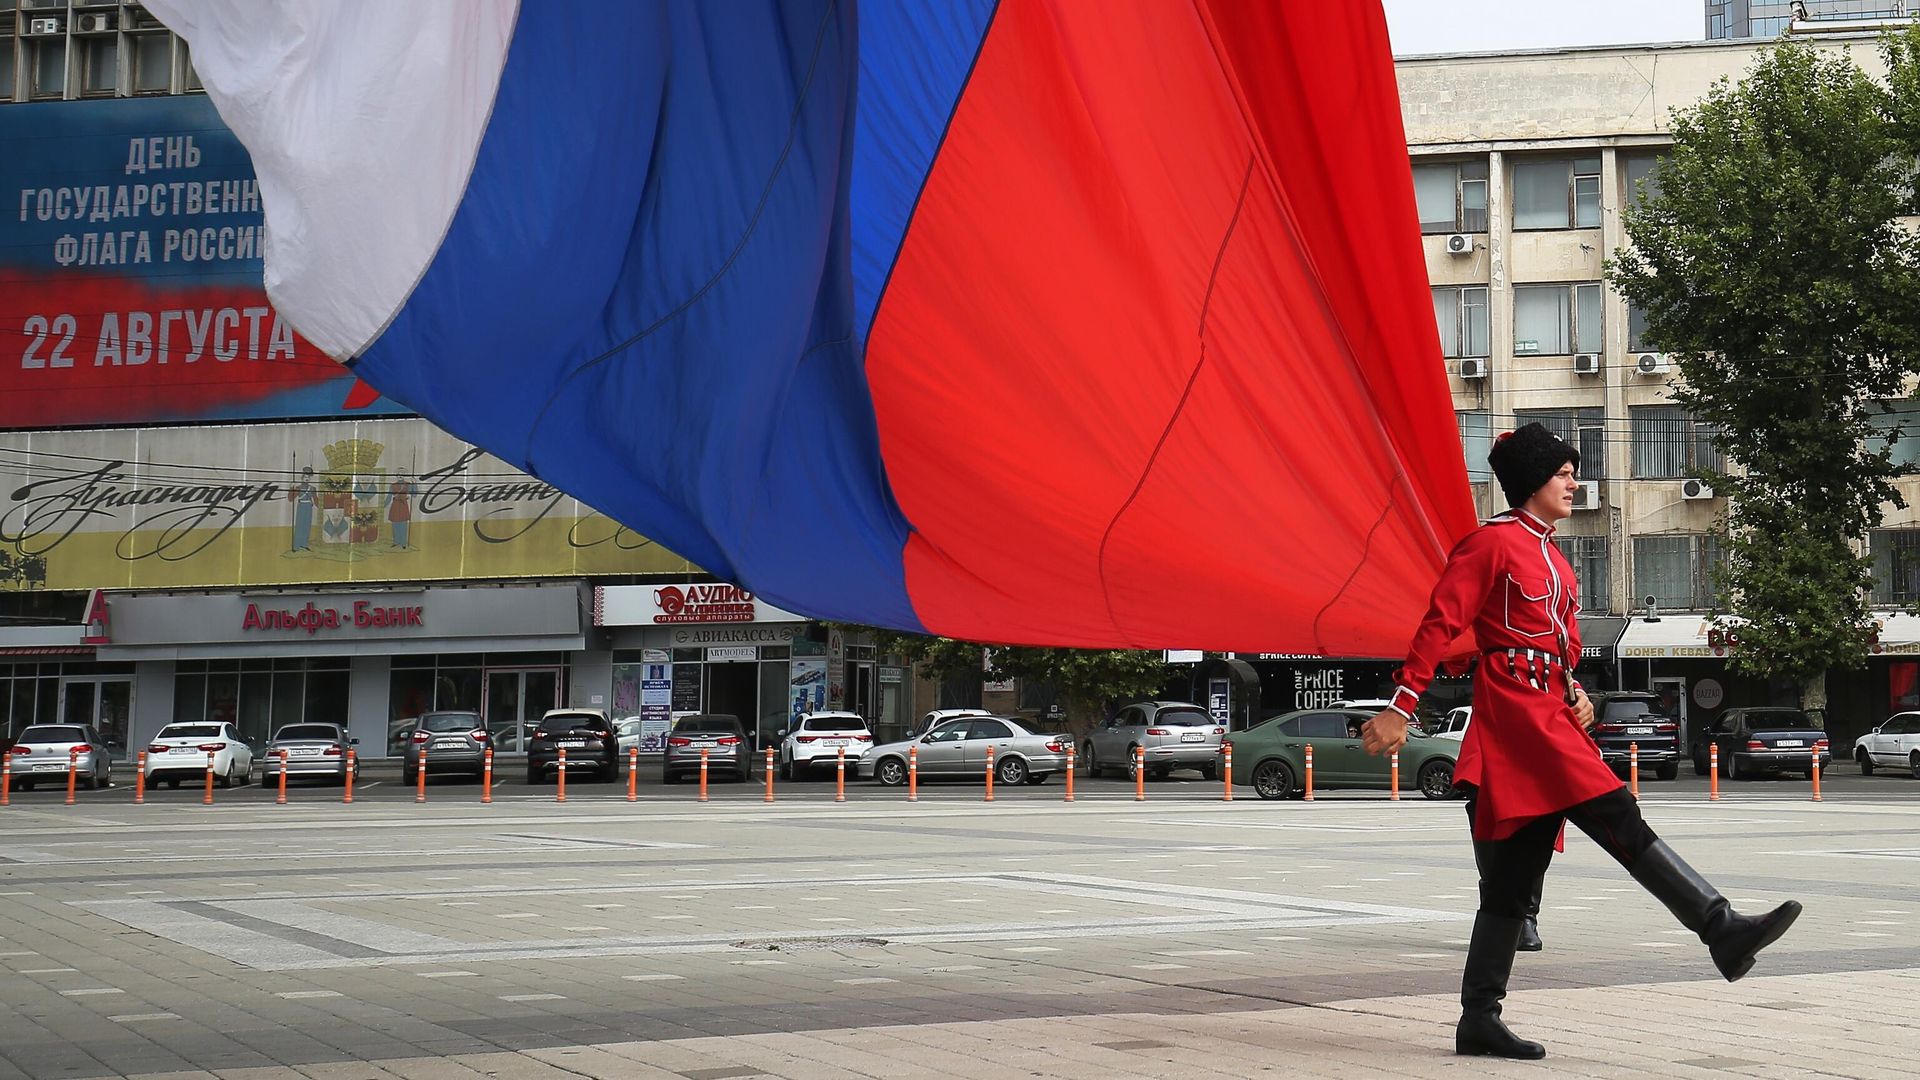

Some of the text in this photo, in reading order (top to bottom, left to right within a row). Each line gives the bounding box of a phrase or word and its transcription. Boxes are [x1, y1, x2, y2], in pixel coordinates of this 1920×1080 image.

[125, 135, 201, 175] ДЕНЬ
[54, 230, 152, 266] ФЛАГА
[21, 306, 296, 369] 22 АВГУСТА
[0, 460, 287, 562] Краснодар
[685, 585, 755, 603] АУДИО
[655, 613, 751, 623] слуховые аппараты
[692, 627, 777, 644] АВИАКАССА
[1625, 647, 1712, 657] DONER KEBAB
[1885, 644, 1920, 654] DONE
[1303, 669, 1344, 689] PRICE
